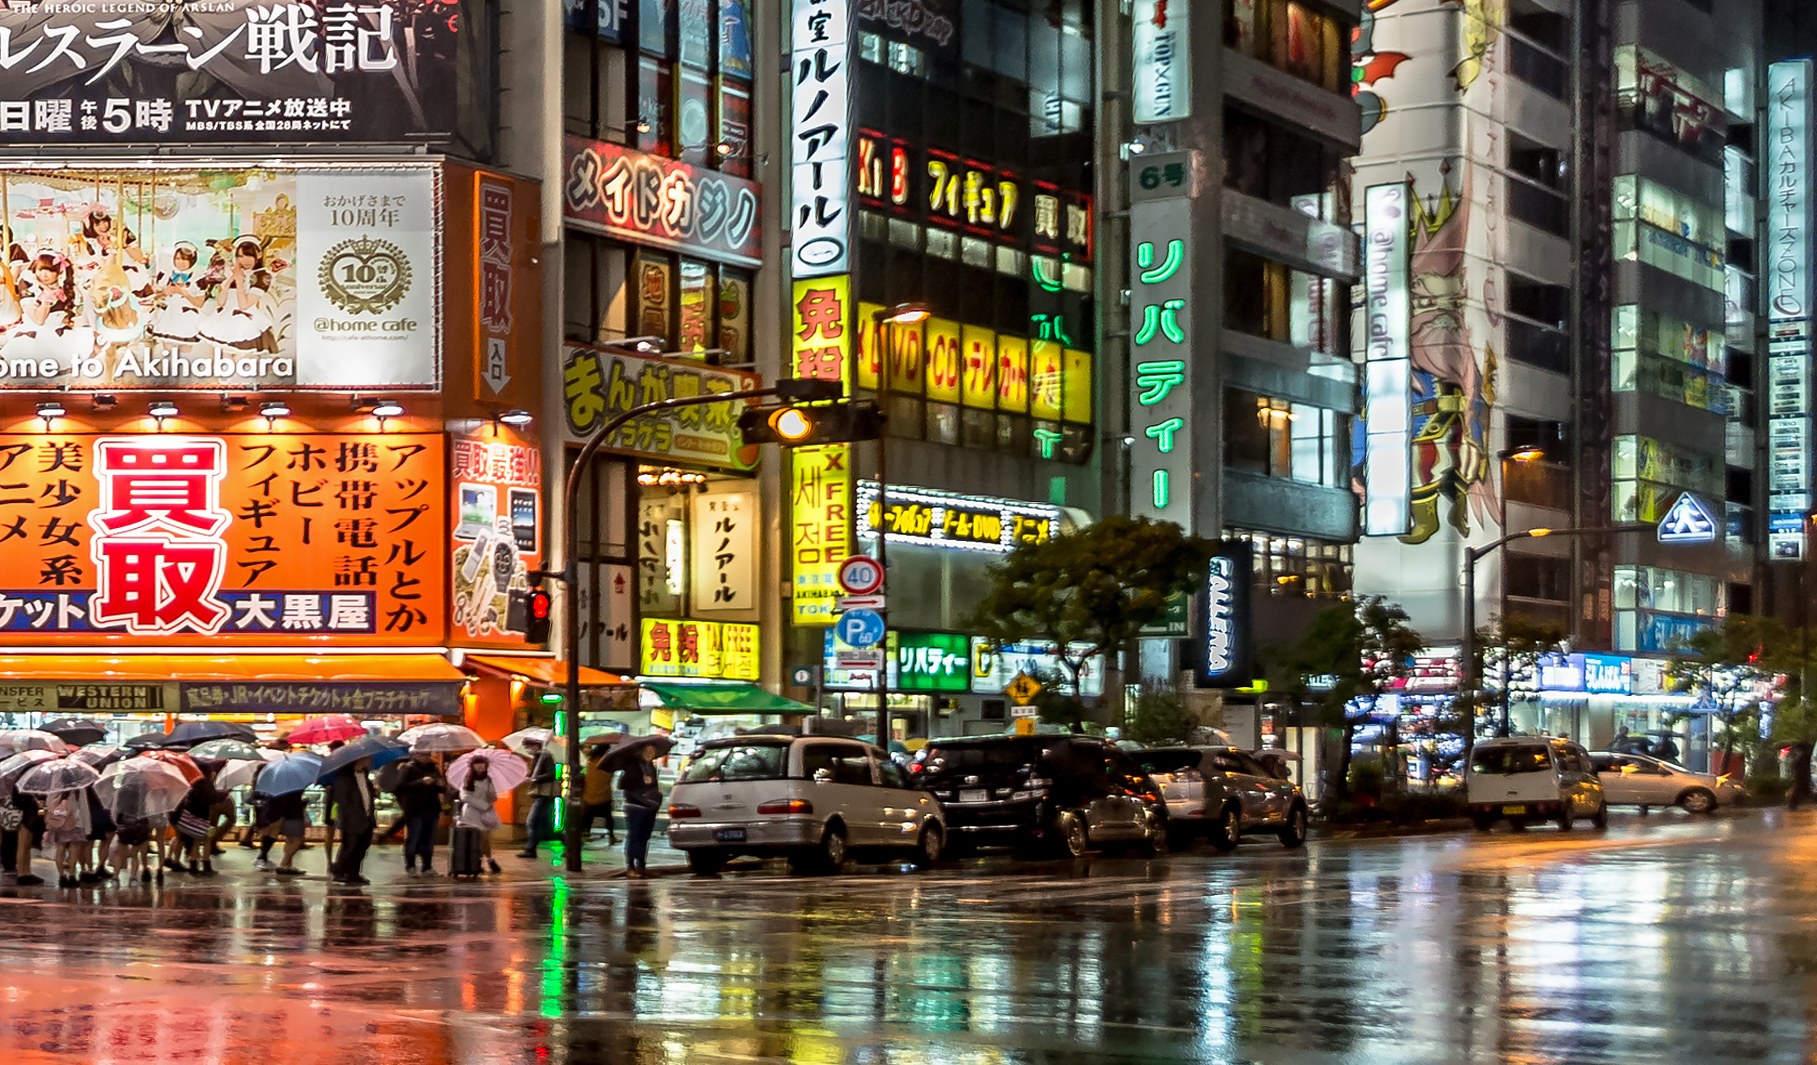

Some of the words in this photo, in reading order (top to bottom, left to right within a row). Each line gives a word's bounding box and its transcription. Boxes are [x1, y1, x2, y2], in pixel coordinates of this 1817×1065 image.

[12, 3, 40, 15] THE
[44, 2, 97, 14] HEROIC
[101, 2, 157, 14] LEGEND
[158, 2, 177, 13] OF
[181, 1, 235, 13] ARSLAN
[185, 98, 352, 118] TVアニメ放送中
[323, 194, 406, 208] おかげさまで
[567, 145, 756, 250] メイドカジノ
[330, 208, 400, 228] 10周年
[314, 318, 378, 333] @home
[381, 317, 418, 332] cafe
[72, 351, 102, 380] to
[114, 349, 294, 380] Akihabara
[490, 342, 503, 380] 入口
[1136, 239, 1185, 510] リバティー
[286, 441, 329, 546] ホビー
[38, 441, 83, 585] 美少女系
[239, 442, 280, 587] フィギュア
[334, 441, 380, 587] 携帯電話
[95, 438, 228, 633] 買取
[384, 441, 428, 633] アップルとか
[714, 516, 738, 604] ルノアール
[846, 566, 873, 585] 40
[235, 594, 371, 630] 大黒屋
[900, 646, 969, 675] リバティー
[58, 685, 148, 698] WESTERN
[86, 697, 147, 709] UNION
